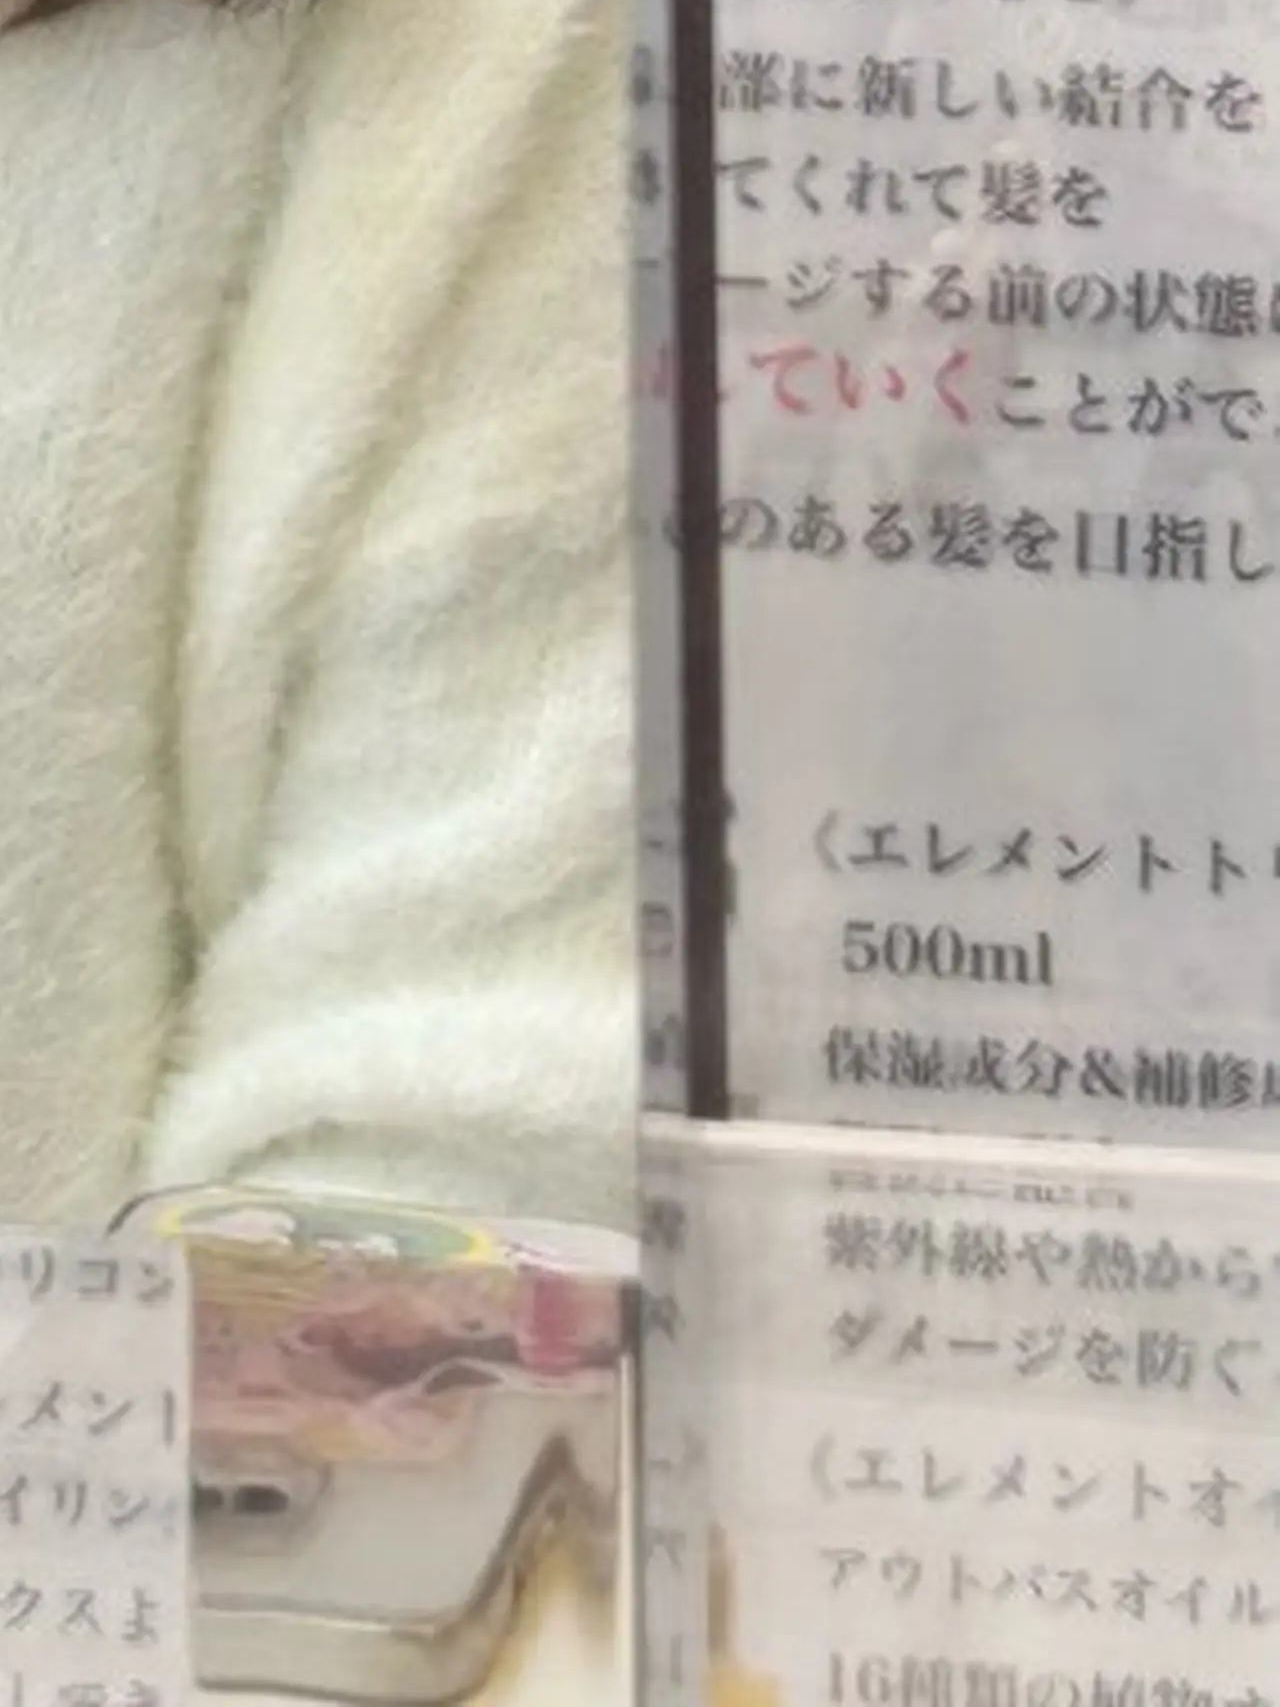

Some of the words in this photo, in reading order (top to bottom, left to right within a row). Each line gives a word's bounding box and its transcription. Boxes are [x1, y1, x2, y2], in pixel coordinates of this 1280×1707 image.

[716, 155, 1108, 227] てくれて髪を
[723, 345, 1280, 441] ていくことがで
[842, 921, 1053, 986] 500ml
[824, 1211, 1280, 1301] 紫外線や熱から
[828, 1305, 1280, 1397] ダメージを防ぐ
